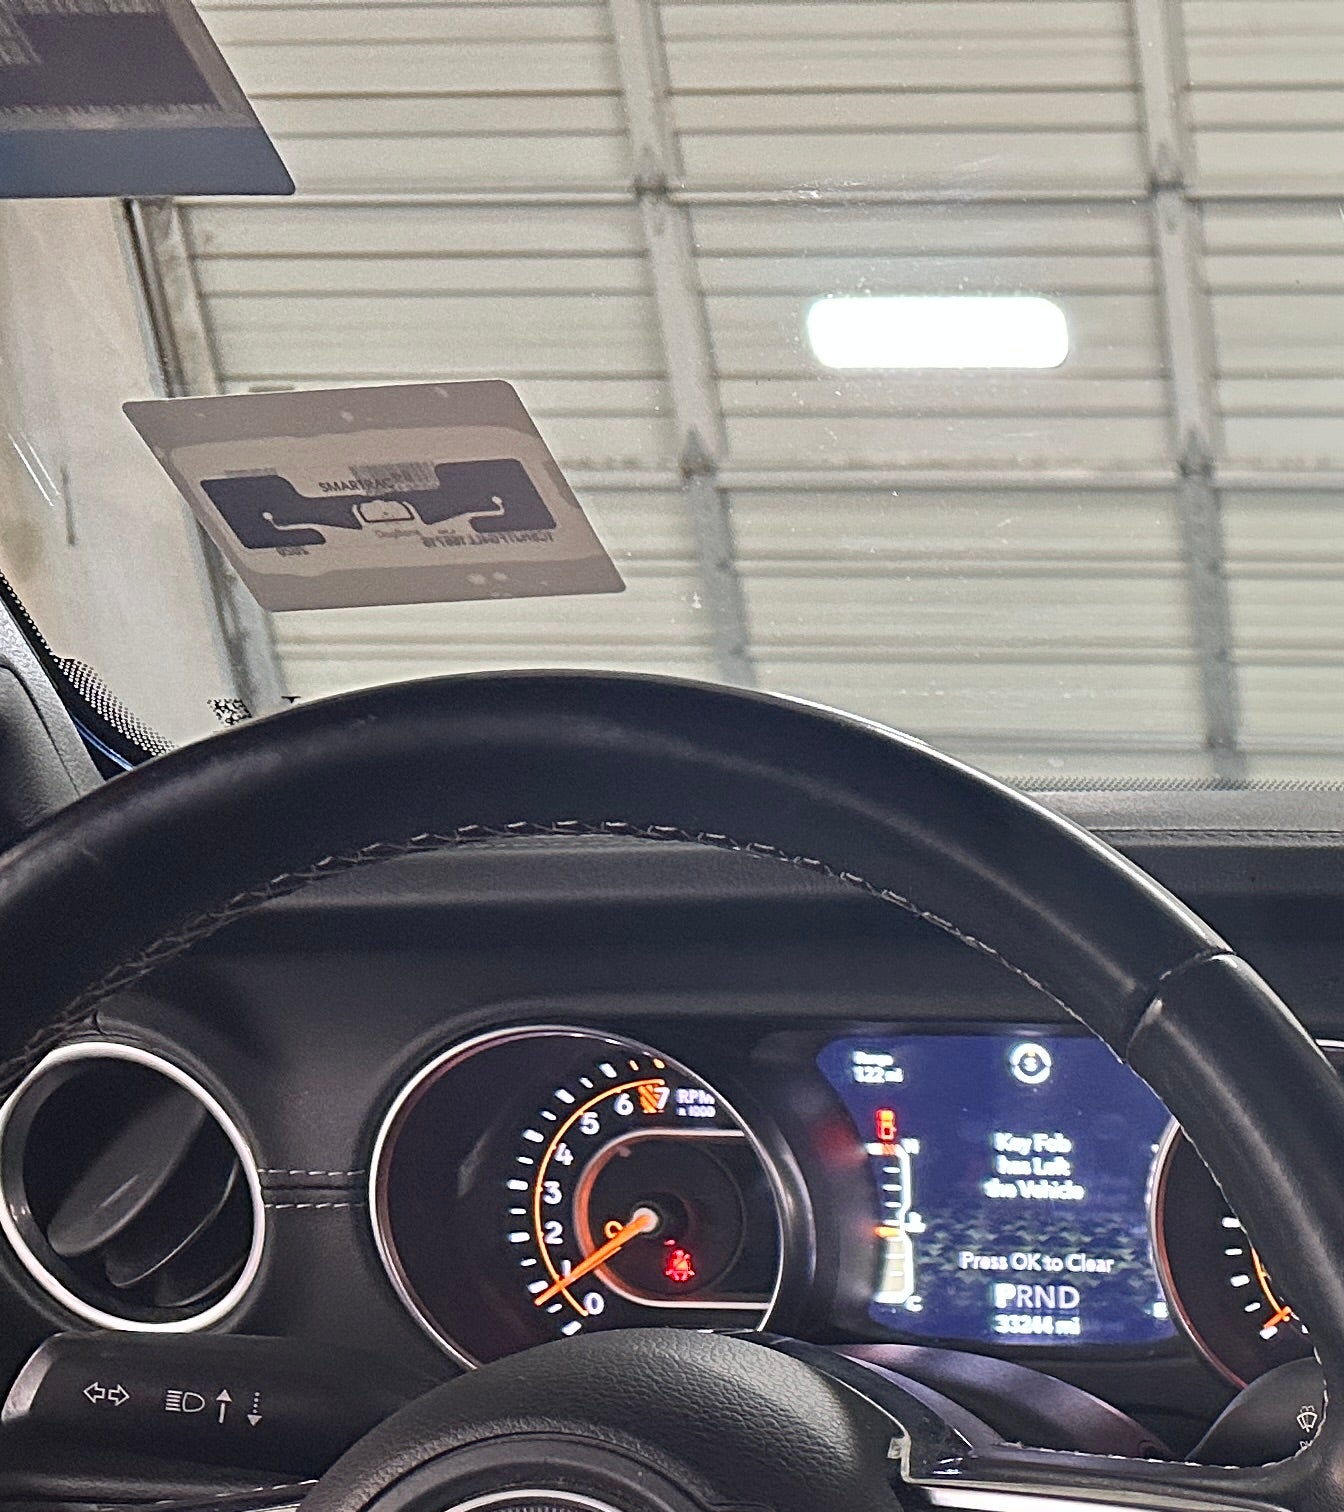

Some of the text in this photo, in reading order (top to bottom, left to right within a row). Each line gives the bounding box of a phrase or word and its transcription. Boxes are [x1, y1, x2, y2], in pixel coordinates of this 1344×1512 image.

[614, 1093, 634, 1115] 6
[653, 1086, 671, 1110] 7
[676, 1088, 716, 1105] RPM
[579, 1112, 600, 1135] 5
[555, 1142, 574, 1165] 4
[993, 1132, 1073, 1155] Key Fob
[543, 1181, 563, 1205] 3
[1017, 1179, 1086, 1200] Vehicle
[544, 1222, 563, 1245] 2
[561, 1259, 571, 1278] 1
[959, 1251, 1115, 1273] Press OK to Clear
[583, 1291, 605, 1315] 0
[1054, 1316, 1081, 1335] mi
